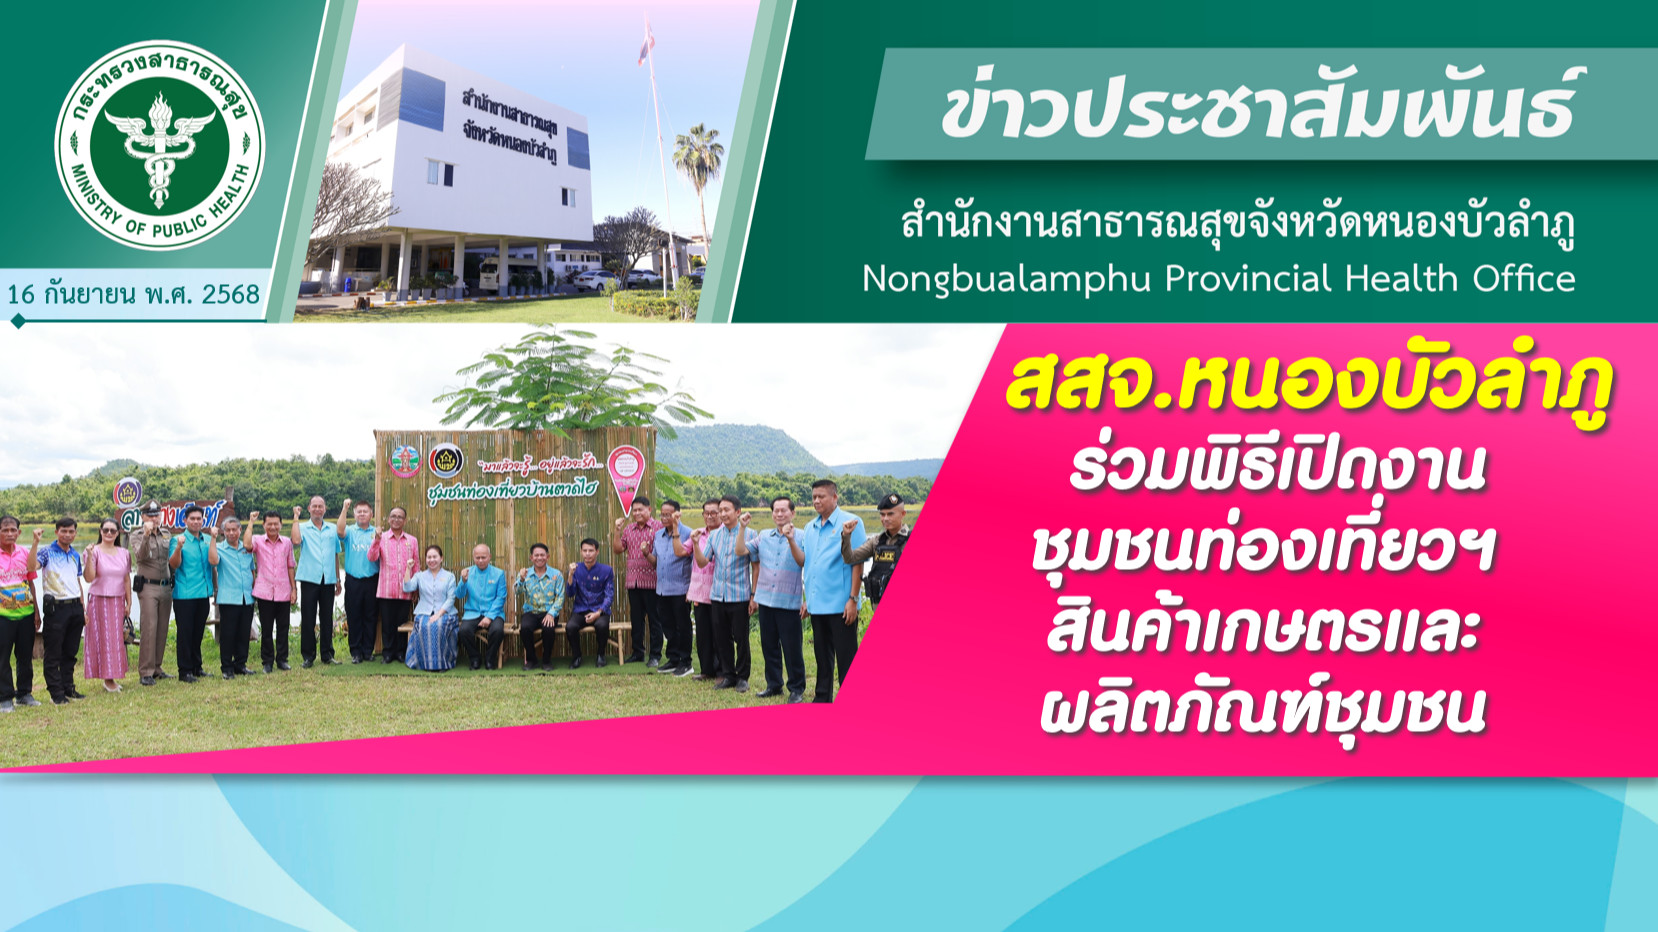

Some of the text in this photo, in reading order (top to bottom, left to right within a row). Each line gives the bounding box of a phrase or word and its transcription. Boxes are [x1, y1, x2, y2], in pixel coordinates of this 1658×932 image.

[462, 118, 558, 166] จังหวัดหนองบัวลำภู
